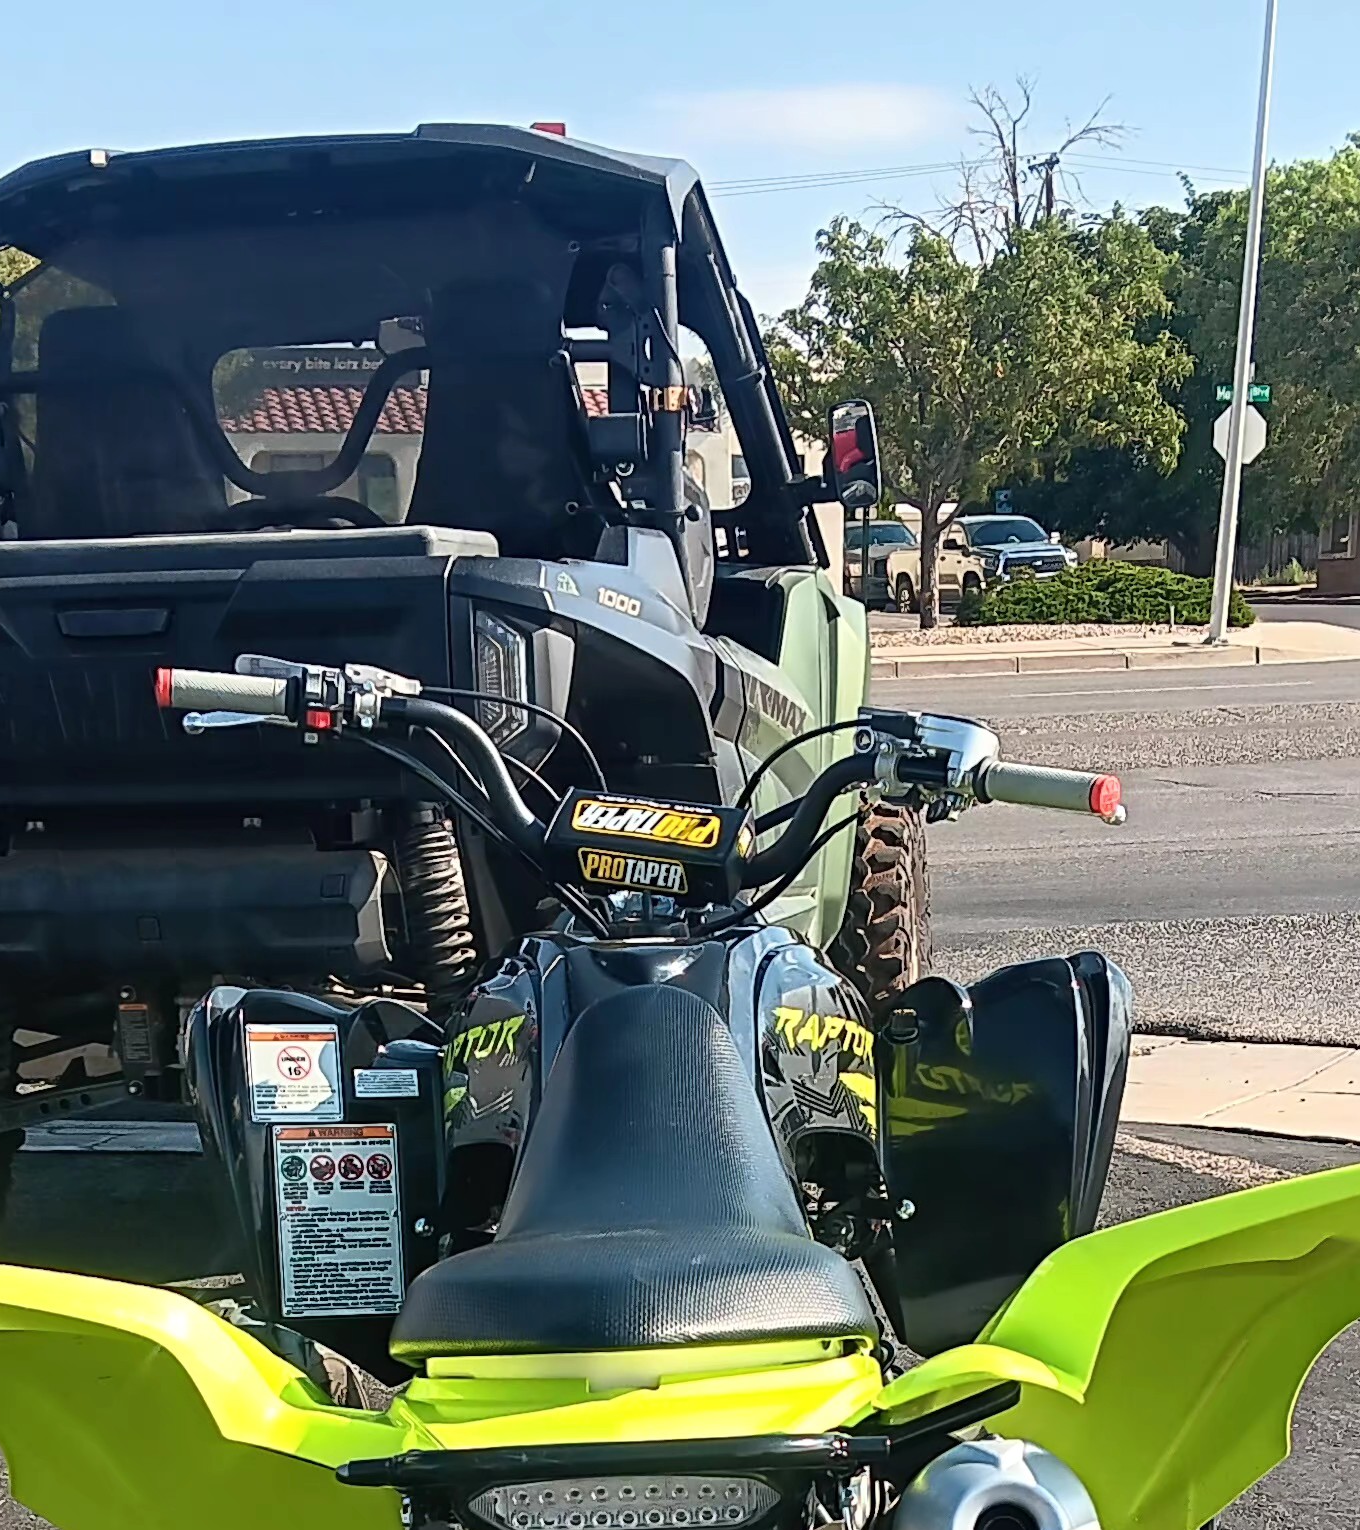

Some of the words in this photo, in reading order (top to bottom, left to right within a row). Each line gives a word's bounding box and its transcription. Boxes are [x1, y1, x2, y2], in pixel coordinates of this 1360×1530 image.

[596, 585, 641, 618] 1000
[578, 802, 712, 844] PROTAPER
[586, 853, 682, 891] PROTAPER
[771, 1006, 875, 1068] RAPTOR
[288, 1066, 302, 1076] 16
[319, 1128, 364, 1137] WARNING
